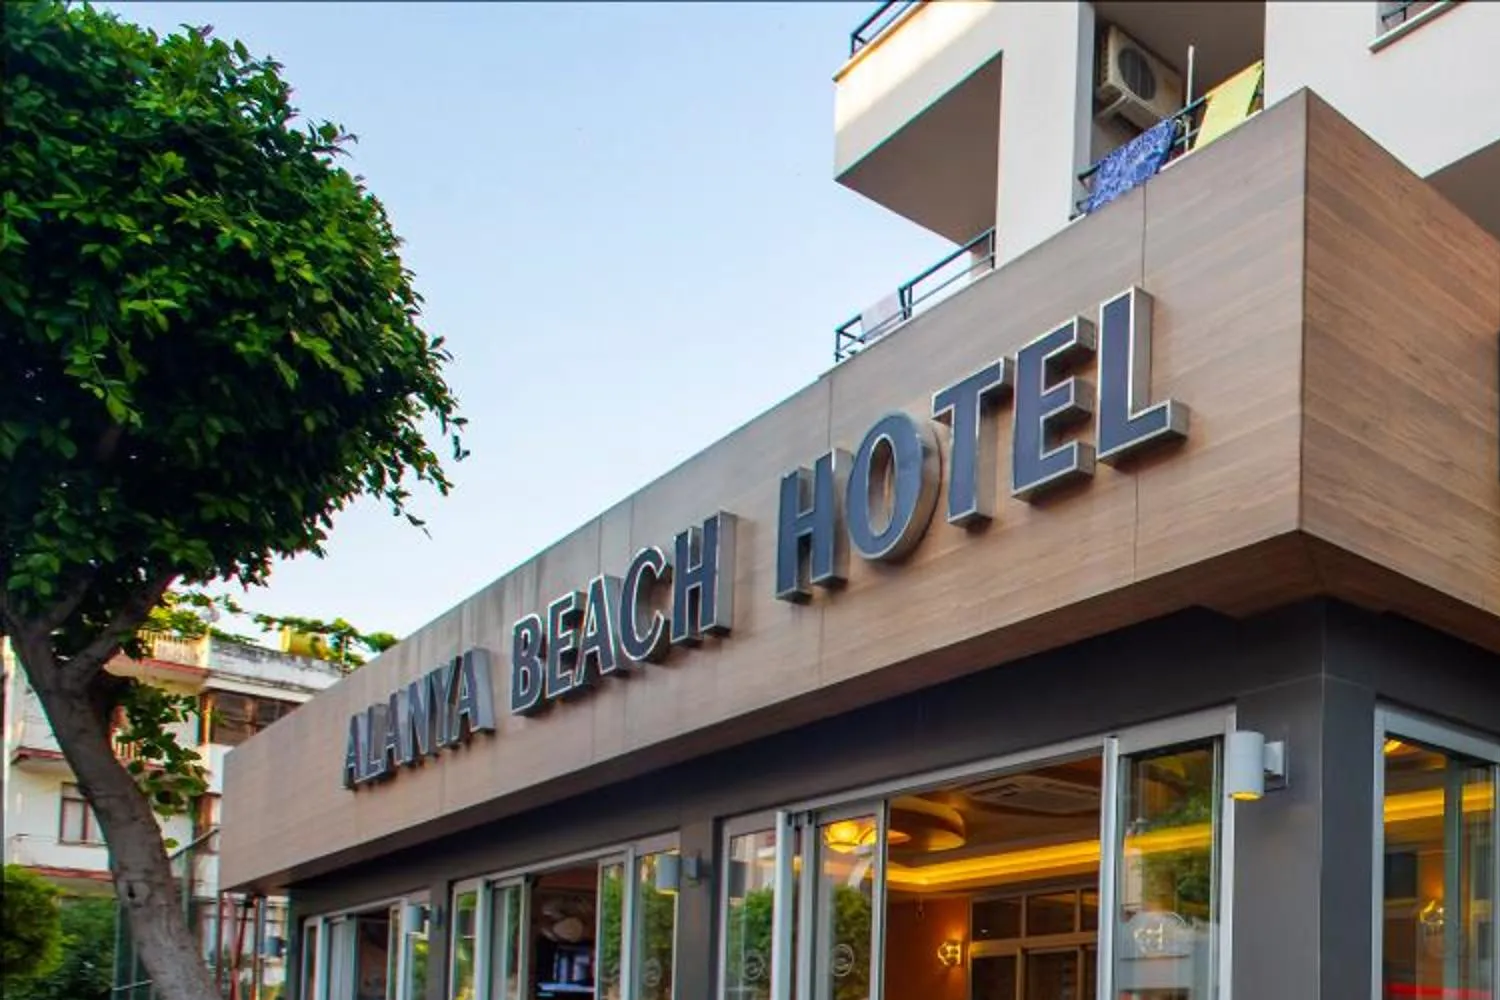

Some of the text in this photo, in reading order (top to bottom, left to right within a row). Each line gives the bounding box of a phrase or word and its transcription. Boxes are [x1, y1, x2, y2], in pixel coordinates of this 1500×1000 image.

[344, 287, 1189, 790] ALANYA BEACH HOTEL
